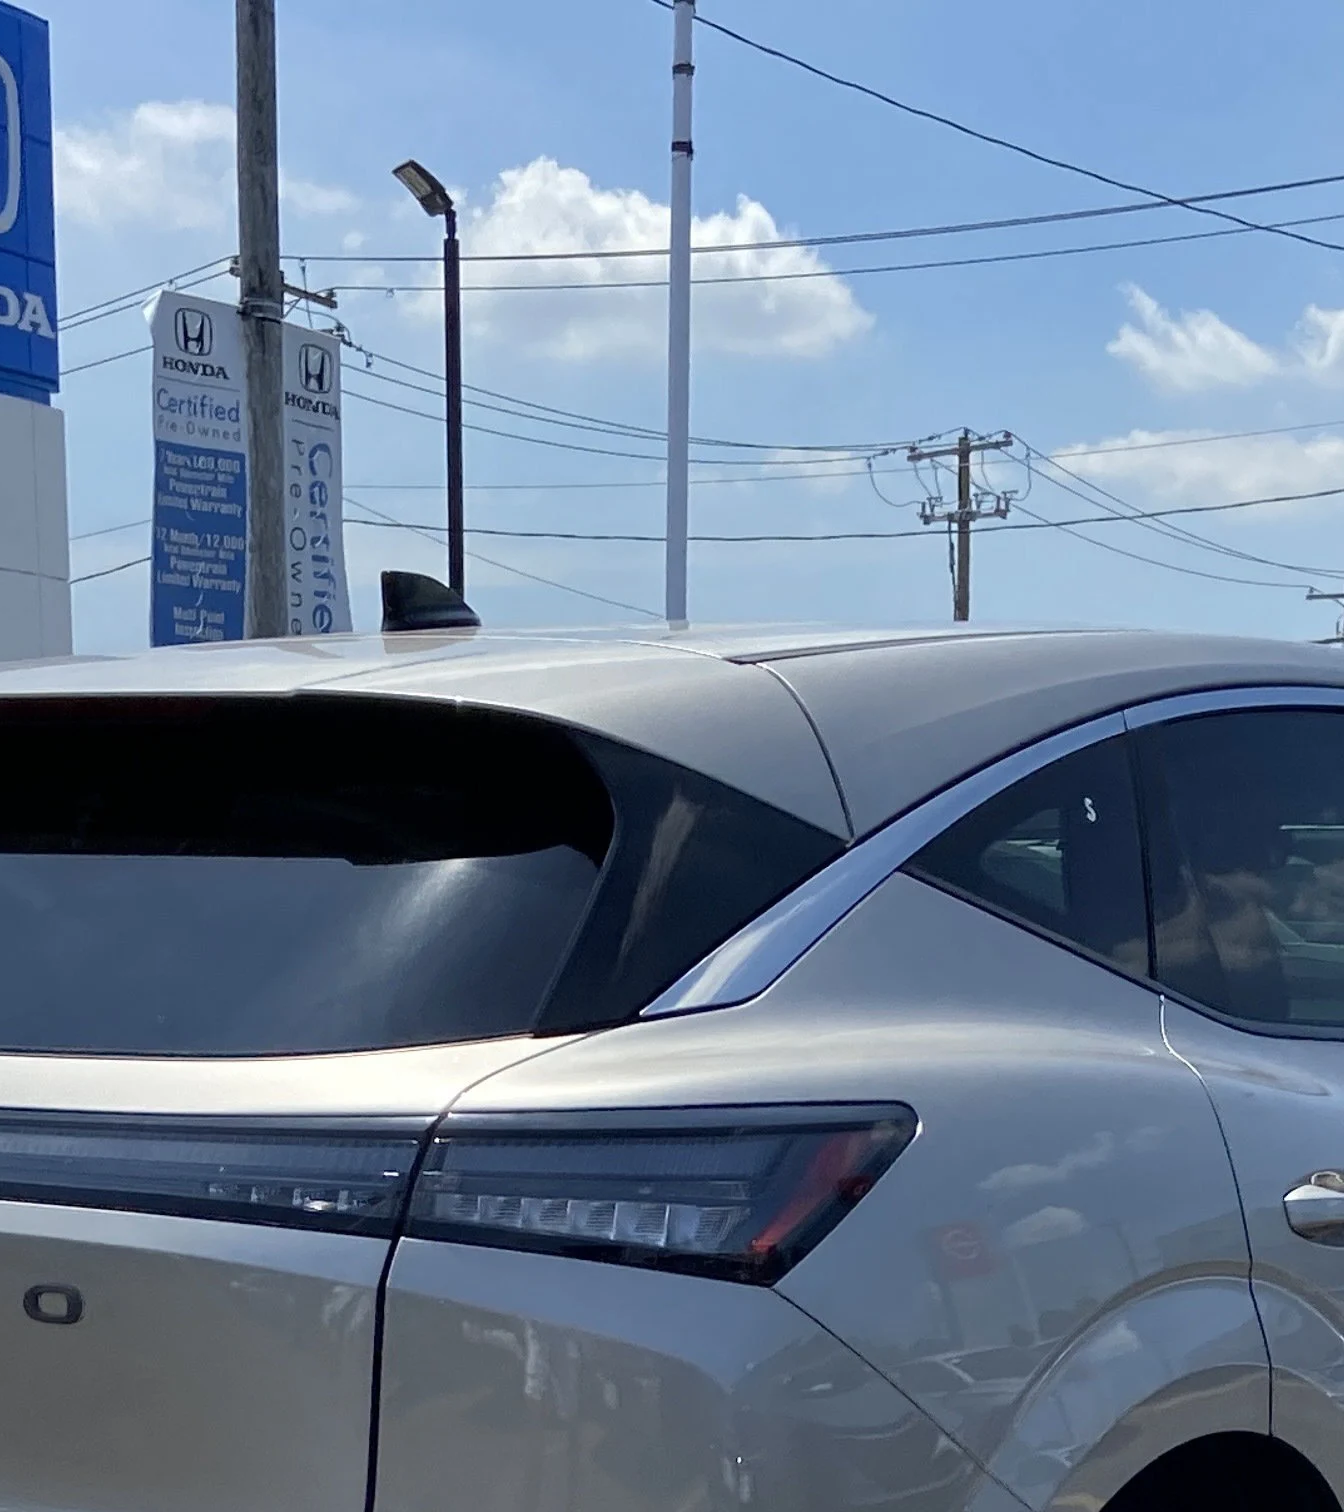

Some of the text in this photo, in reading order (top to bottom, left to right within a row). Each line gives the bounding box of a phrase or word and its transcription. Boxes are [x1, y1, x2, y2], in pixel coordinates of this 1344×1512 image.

[162, 356, 230, 380] HONDA
[157, 388, 240, 423] Certified
[308, 443, 336, 634] Certifie
